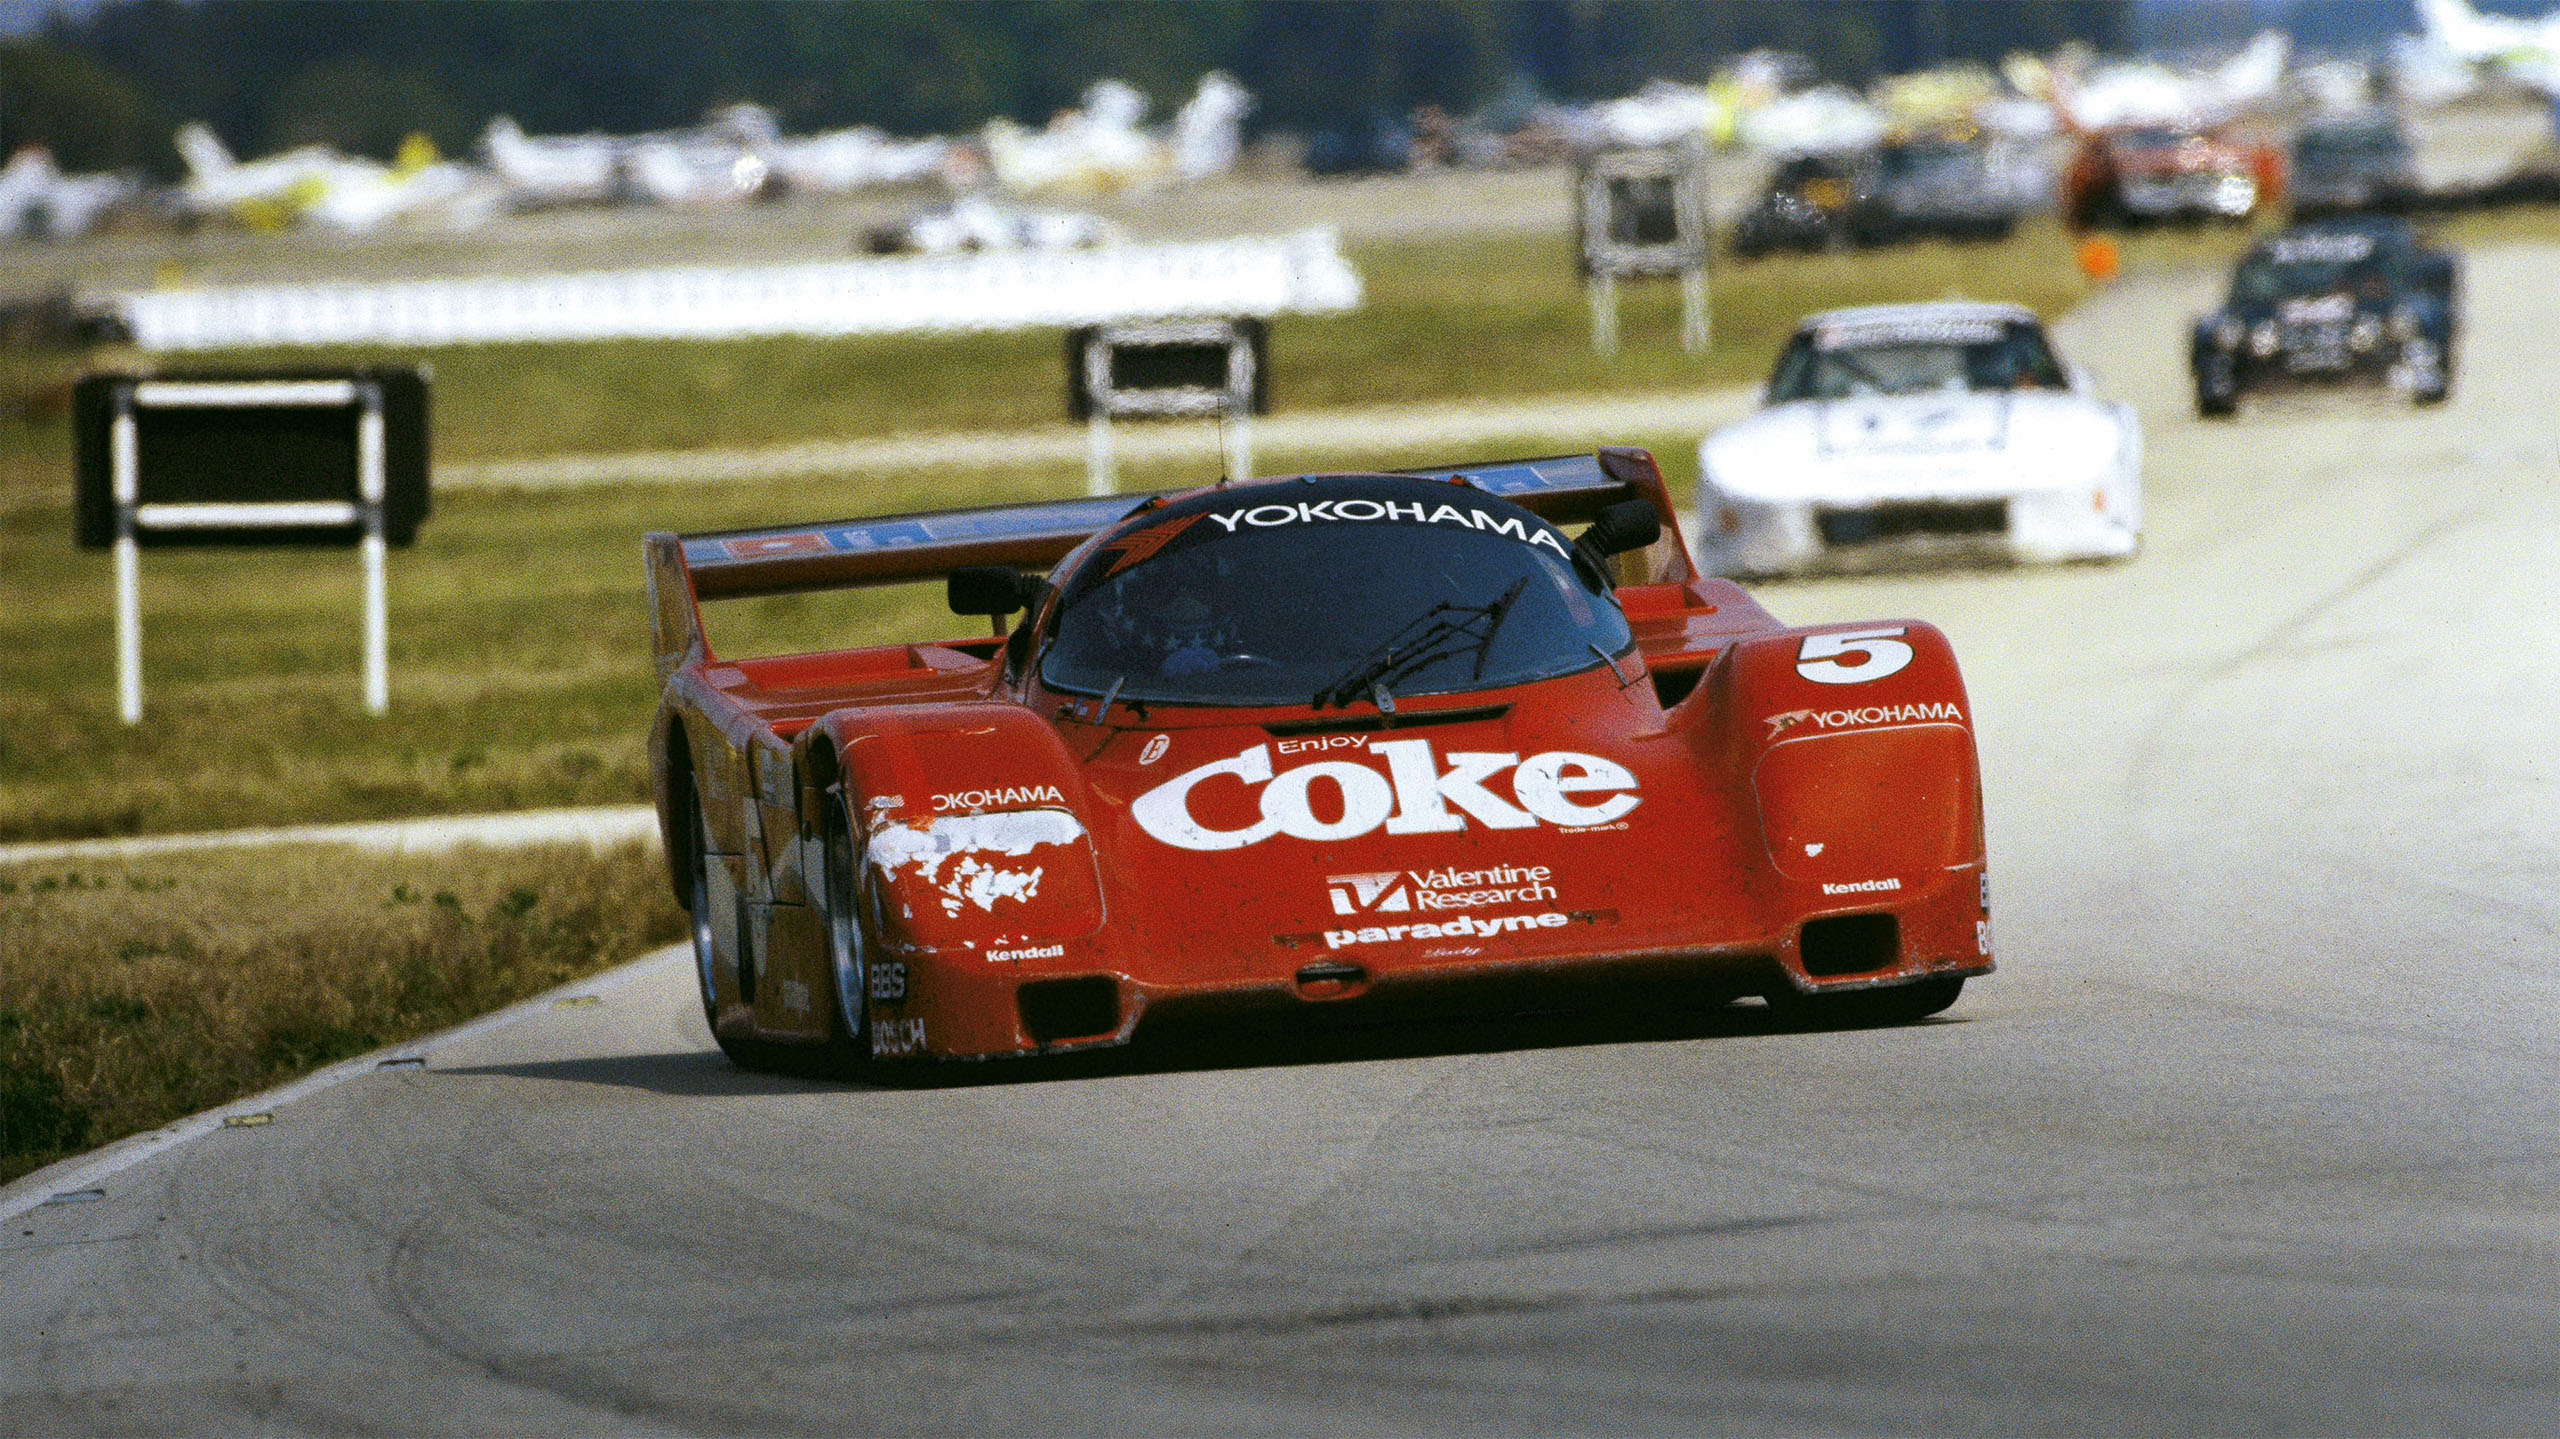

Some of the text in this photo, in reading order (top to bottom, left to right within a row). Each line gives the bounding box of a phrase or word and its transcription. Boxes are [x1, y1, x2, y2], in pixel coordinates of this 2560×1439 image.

[1209, 500, 1571, 560] YOKOHAMA
[1796, 626, 1914, 684] 5
[1812, 702, 1963, 728] YOKOHAMA
[1277, 734, 1367, 755] Enjoy
[931, 786, 1065, 811] OKOHAMA
[1130, 738, 1642, 851] Coke
[1408, 863, 1551, 889] Valentine
[1822, 878, 1900, 895] Kendall
[1416, 882, 1557, 910] Research
[1324, 912, 1568, 950] paradyne
[986, 944, 1064, 962] Kendall
[872, 962, 905, 999] BBS
